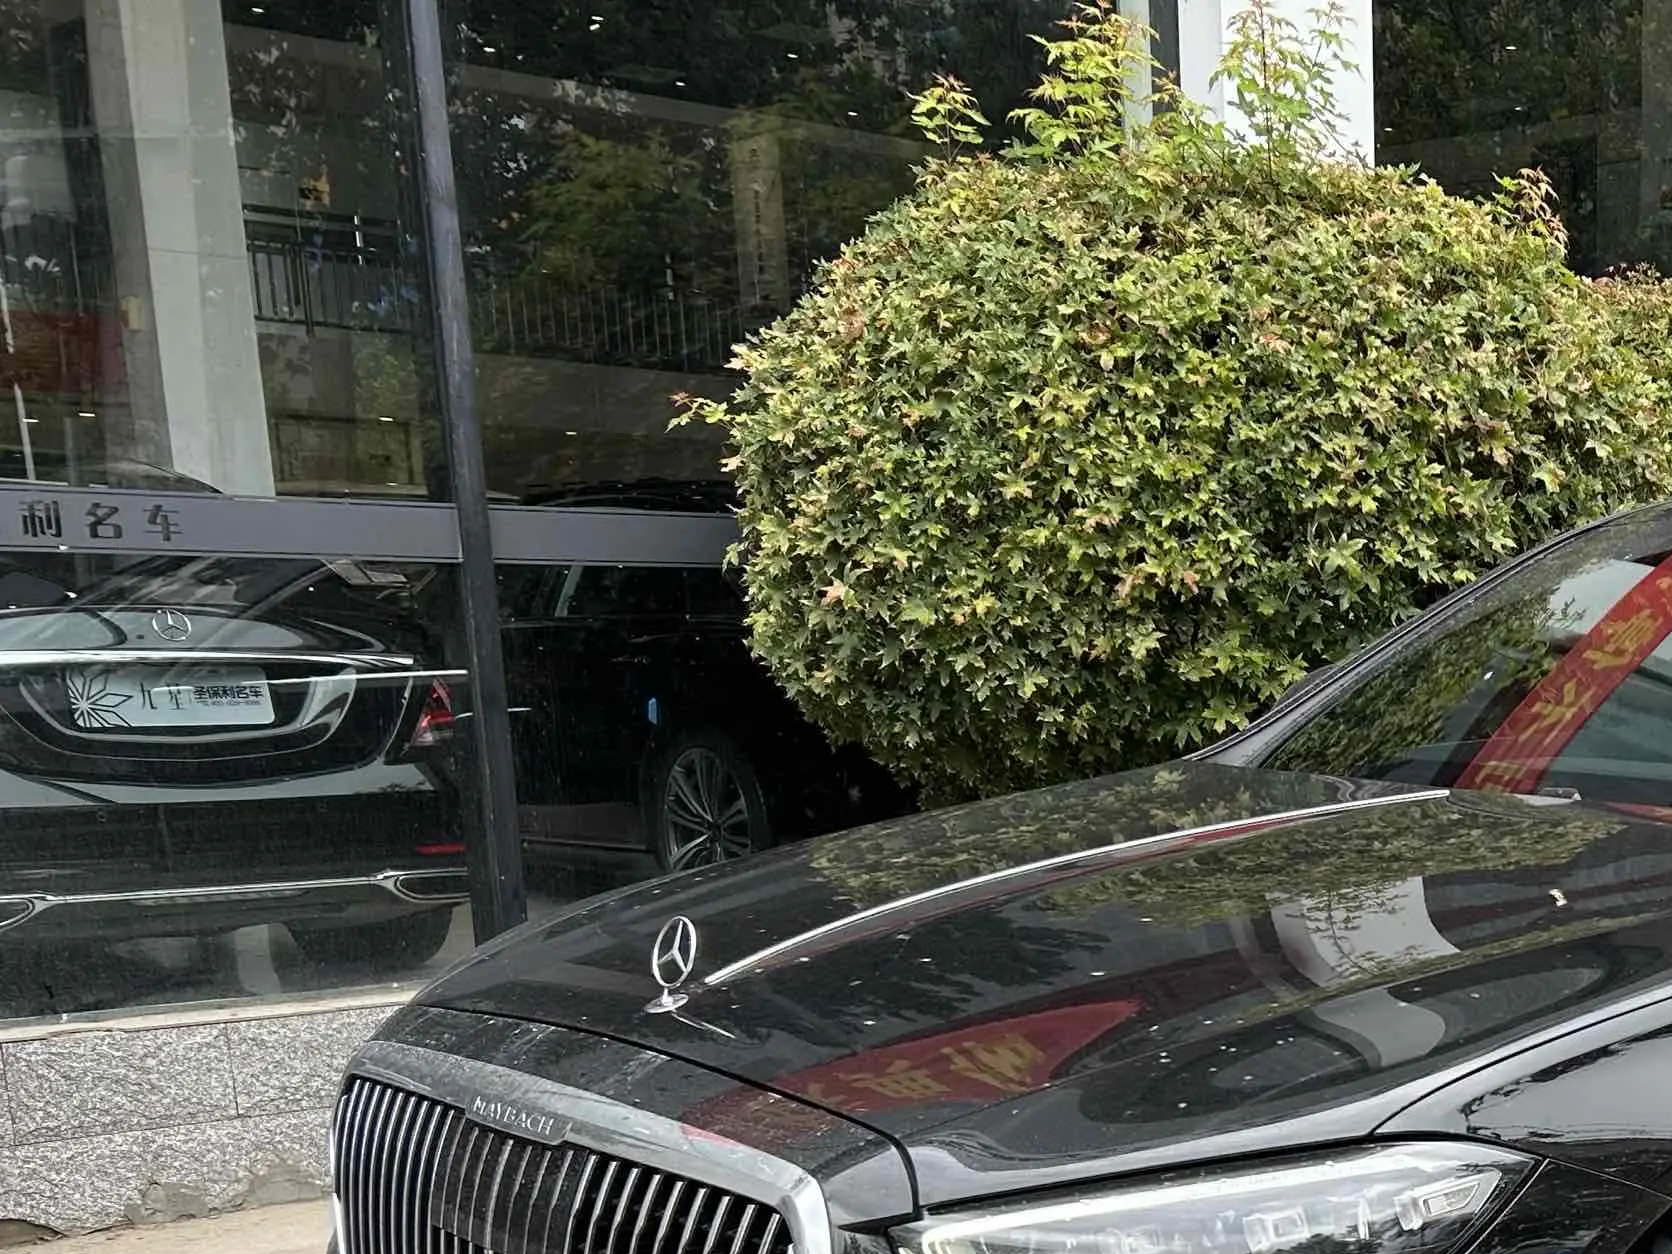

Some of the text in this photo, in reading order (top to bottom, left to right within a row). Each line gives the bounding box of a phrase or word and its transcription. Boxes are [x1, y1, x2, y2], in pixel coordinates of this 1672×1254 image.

[17, 499, 184, 542] 利名车
[472, 1095, 555, 1136] MAYBACH
